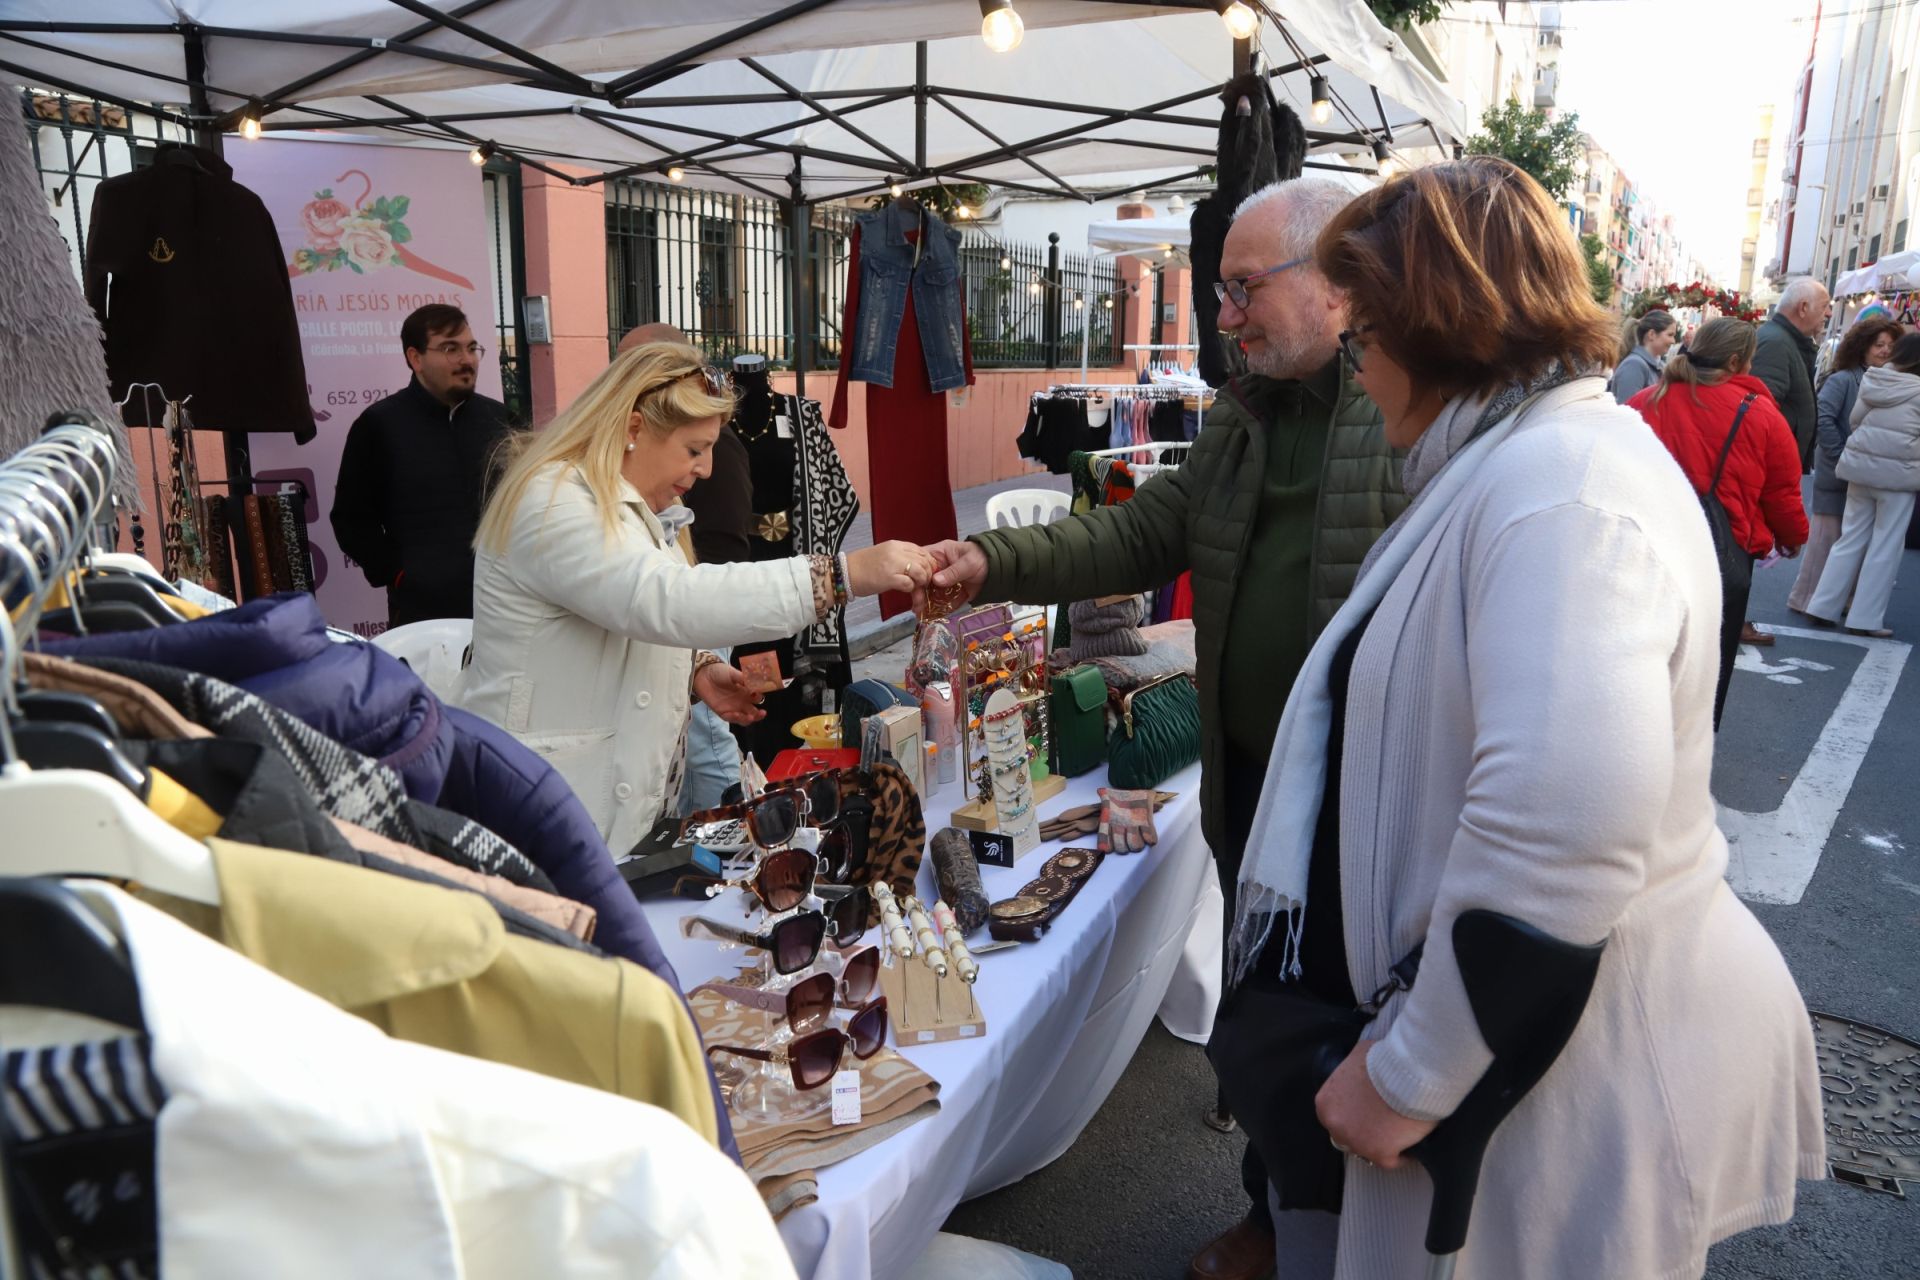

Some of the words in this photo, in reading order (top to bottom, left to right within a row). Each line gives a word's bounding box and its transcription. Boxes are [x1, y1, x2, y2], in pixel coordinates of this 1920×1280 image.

[296, 290, 328, 312] RÍA
[336, 290, 390, 312] JESÚS
[300, 320, 337, 338] CALLE
[327, 390, 358, 406] 652
[362, 389, 389, 405] 921
[353, 621, 389, 638] Mjes
